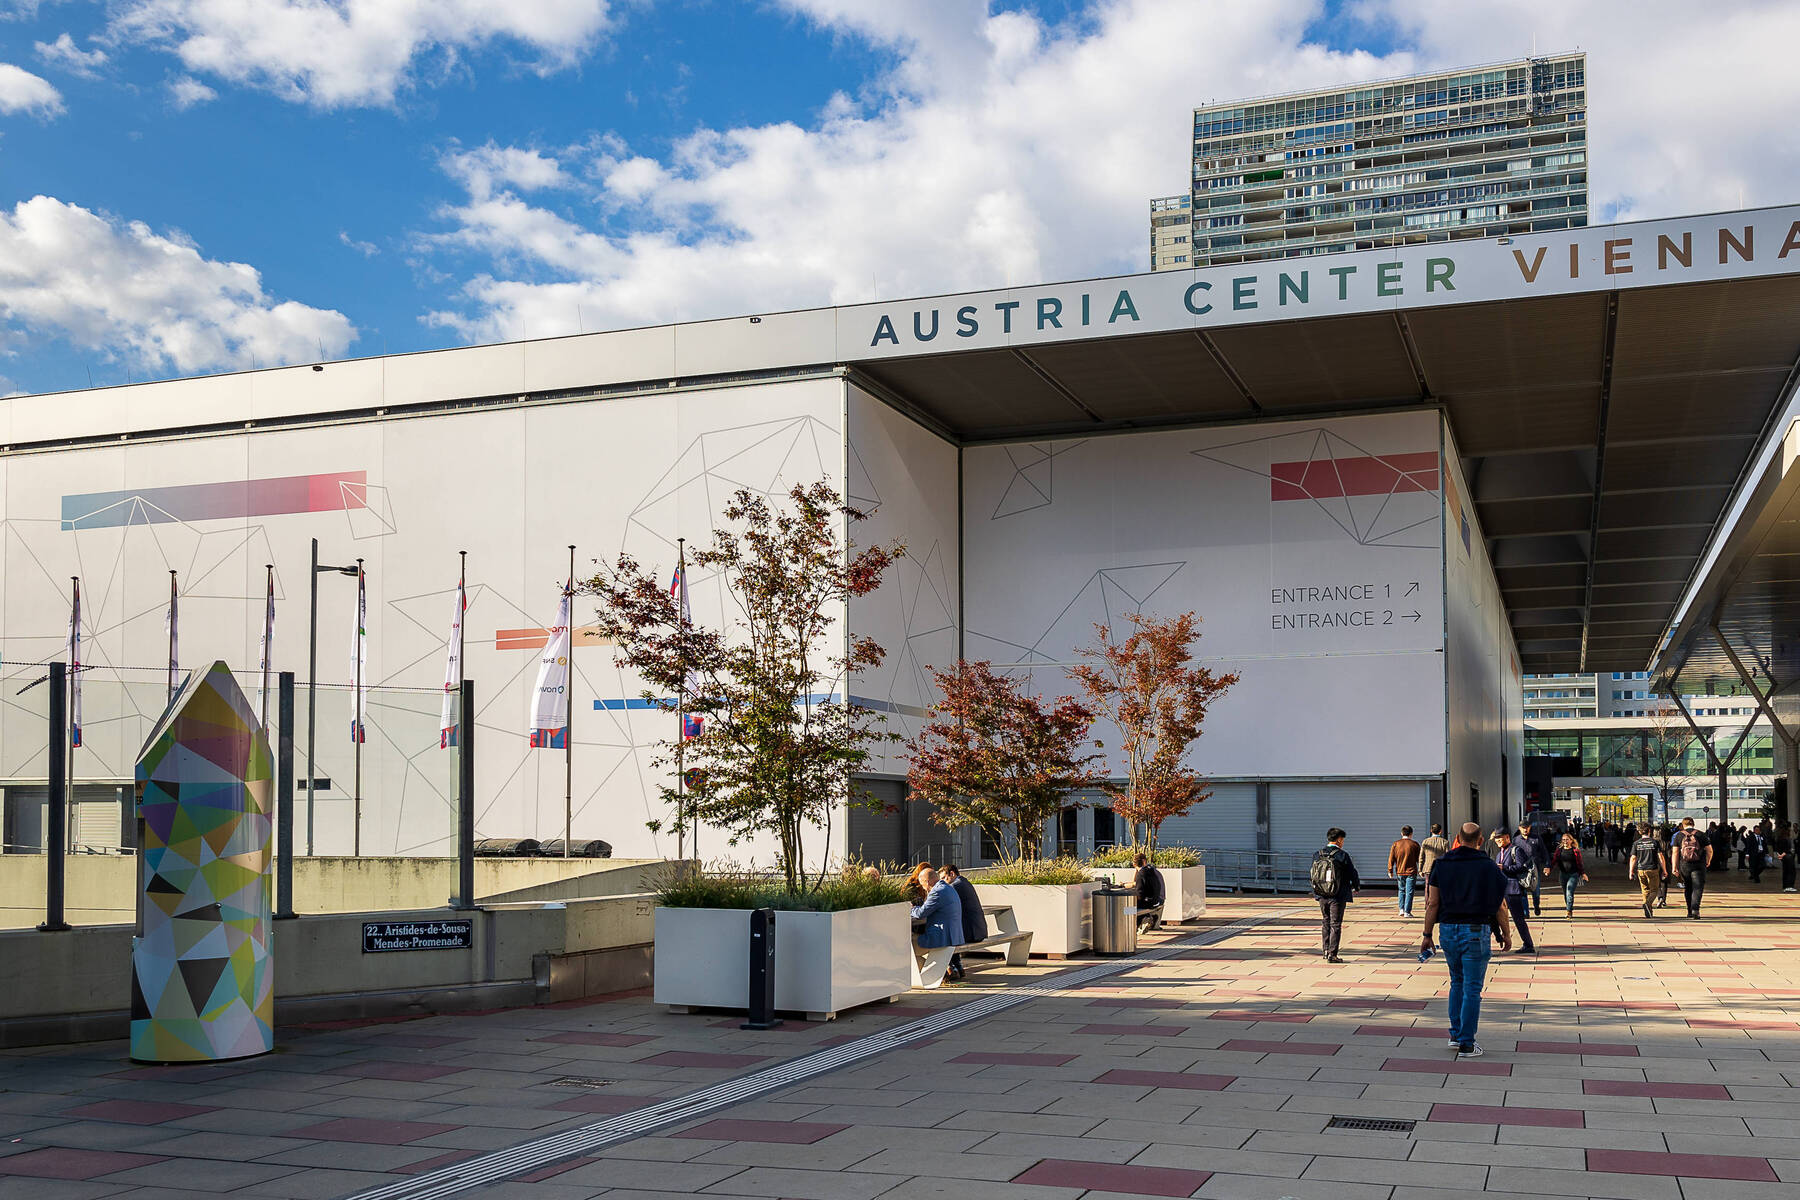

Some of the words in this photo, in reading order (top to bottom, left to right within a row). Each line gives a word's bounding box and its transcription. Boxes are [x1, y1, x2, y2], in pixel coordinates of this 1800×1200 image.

[871, 289, 1141, 346] AUSTRIA
[1184, 257, 1456, 315] CENTER
[1512, 220, 1800, 283] VIENNA
[1271, 584, 1374, 604] ENTRANCE
[1384, 583, 1390, 598] 1
[1271, 611, 1375, 630] ENTRANCE
[1382, 610, 1393, 625] 2
[384, 923, 469, 936] Aristides-de-Sousa-
[373, 936, 463, 949] Mendes-Promenade
